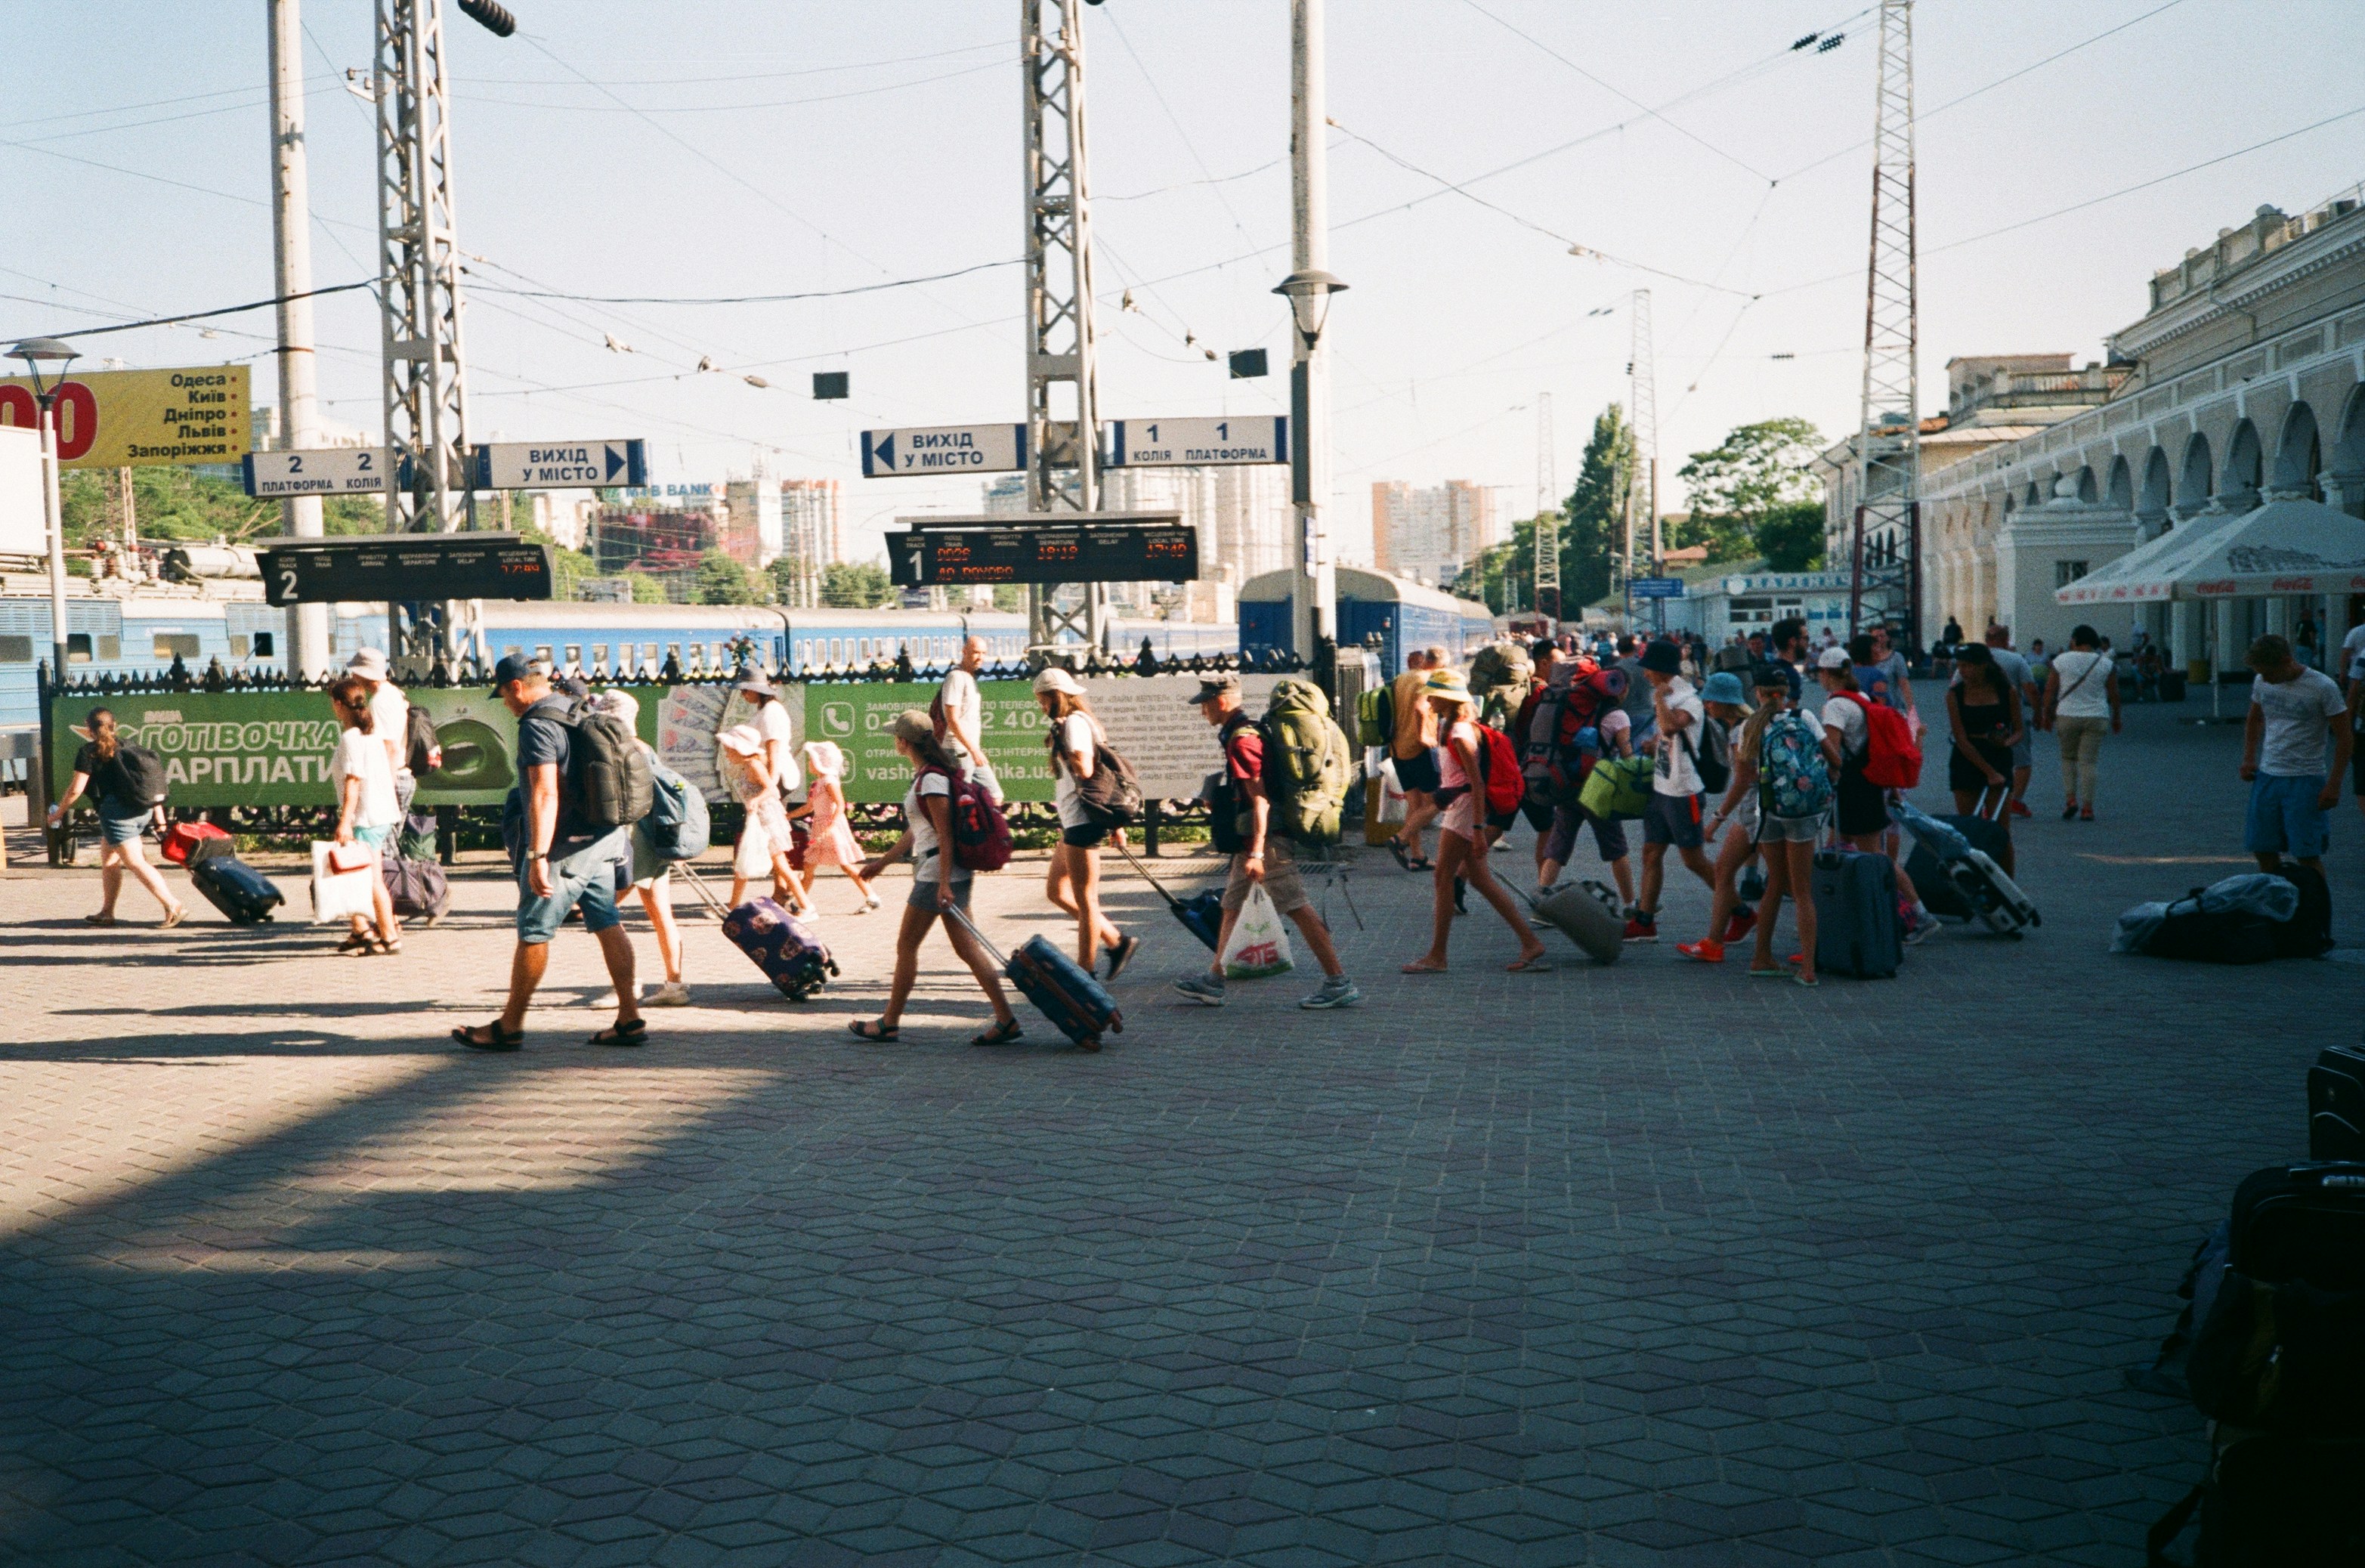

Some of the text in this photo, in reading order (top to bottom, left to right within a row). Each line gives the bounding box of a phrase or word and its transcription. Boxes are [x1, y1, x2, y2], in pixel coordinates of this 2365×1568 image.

[171, 373, 226, 388] Одеса
[188, 389, 226, 404] Київ
[163, 408, 227, 424] Дніпро
[178, 424, 227, 439] Львів
[1146, 422, 1228, 443] 1 1
[913, 432, 973, 449] ВИХІД
[128, 442, 227, 459] Запоріжжя
[530, 447, 589, 464] ВИХІД
[1133, 447, 1267, 462] КОЛІЯ ПЛАТФОРМА
[289, 453, 373, 473] 2 2
[904, 451, 984, 468] У МІСТО
[523, 466, 598, 481] У МІСТО
[262, 477, 382, 492] ПЛАТФОРМА КОЛІЯ
[909, 550, 922, 580] 1
[280, 571, 298, 599] 2
[865, 702, 932, 712] ЗАМОВЛЕНН
[999, 700, 1040, 710] ТЕЛЕФО
[138, 721, 342, 752] ГОТІВОЧКА
[166, 756, 332, 784] АРПЛАТИ
